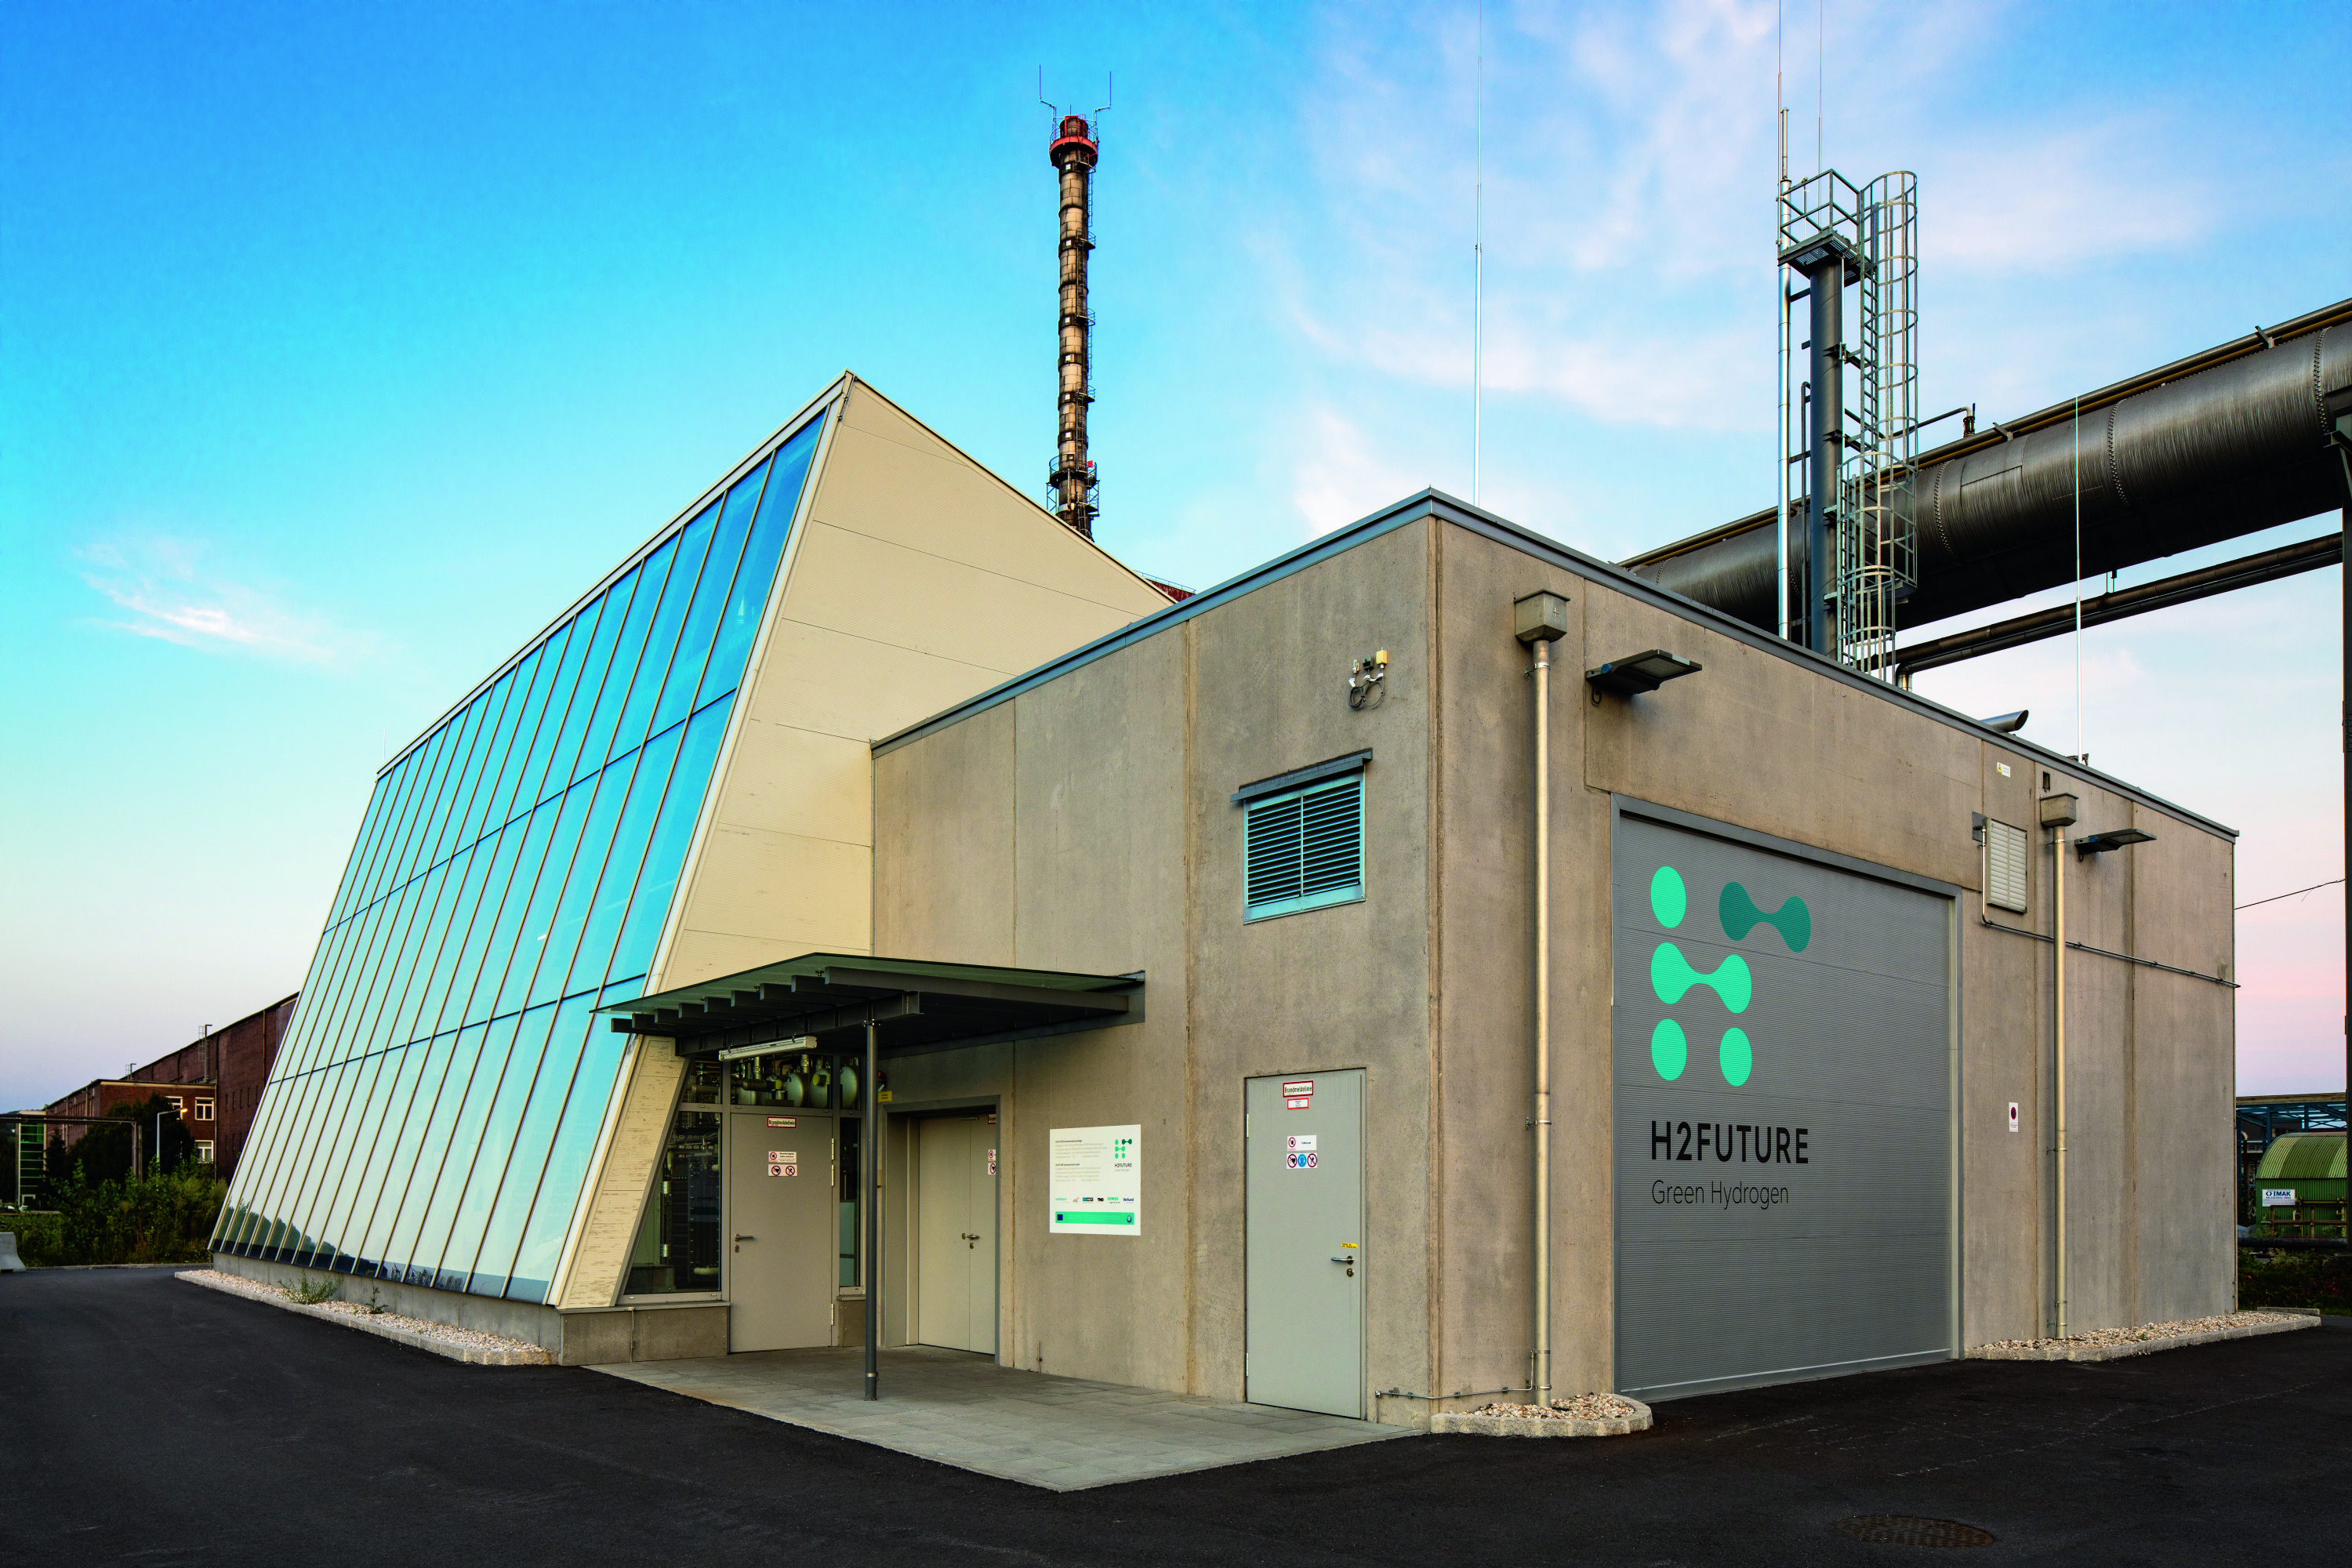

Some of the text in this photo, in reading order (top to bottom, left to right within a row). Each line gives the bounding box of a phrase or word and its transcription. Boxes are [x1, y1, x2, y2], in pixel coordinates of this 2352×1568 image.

[1284, 1085, 1312, 1094] Brandmeldelinie
[1651, 1120, 1809, 1163] H2FUTURE
[1652, 1179, 1788, 1210] Green Hydrogen
